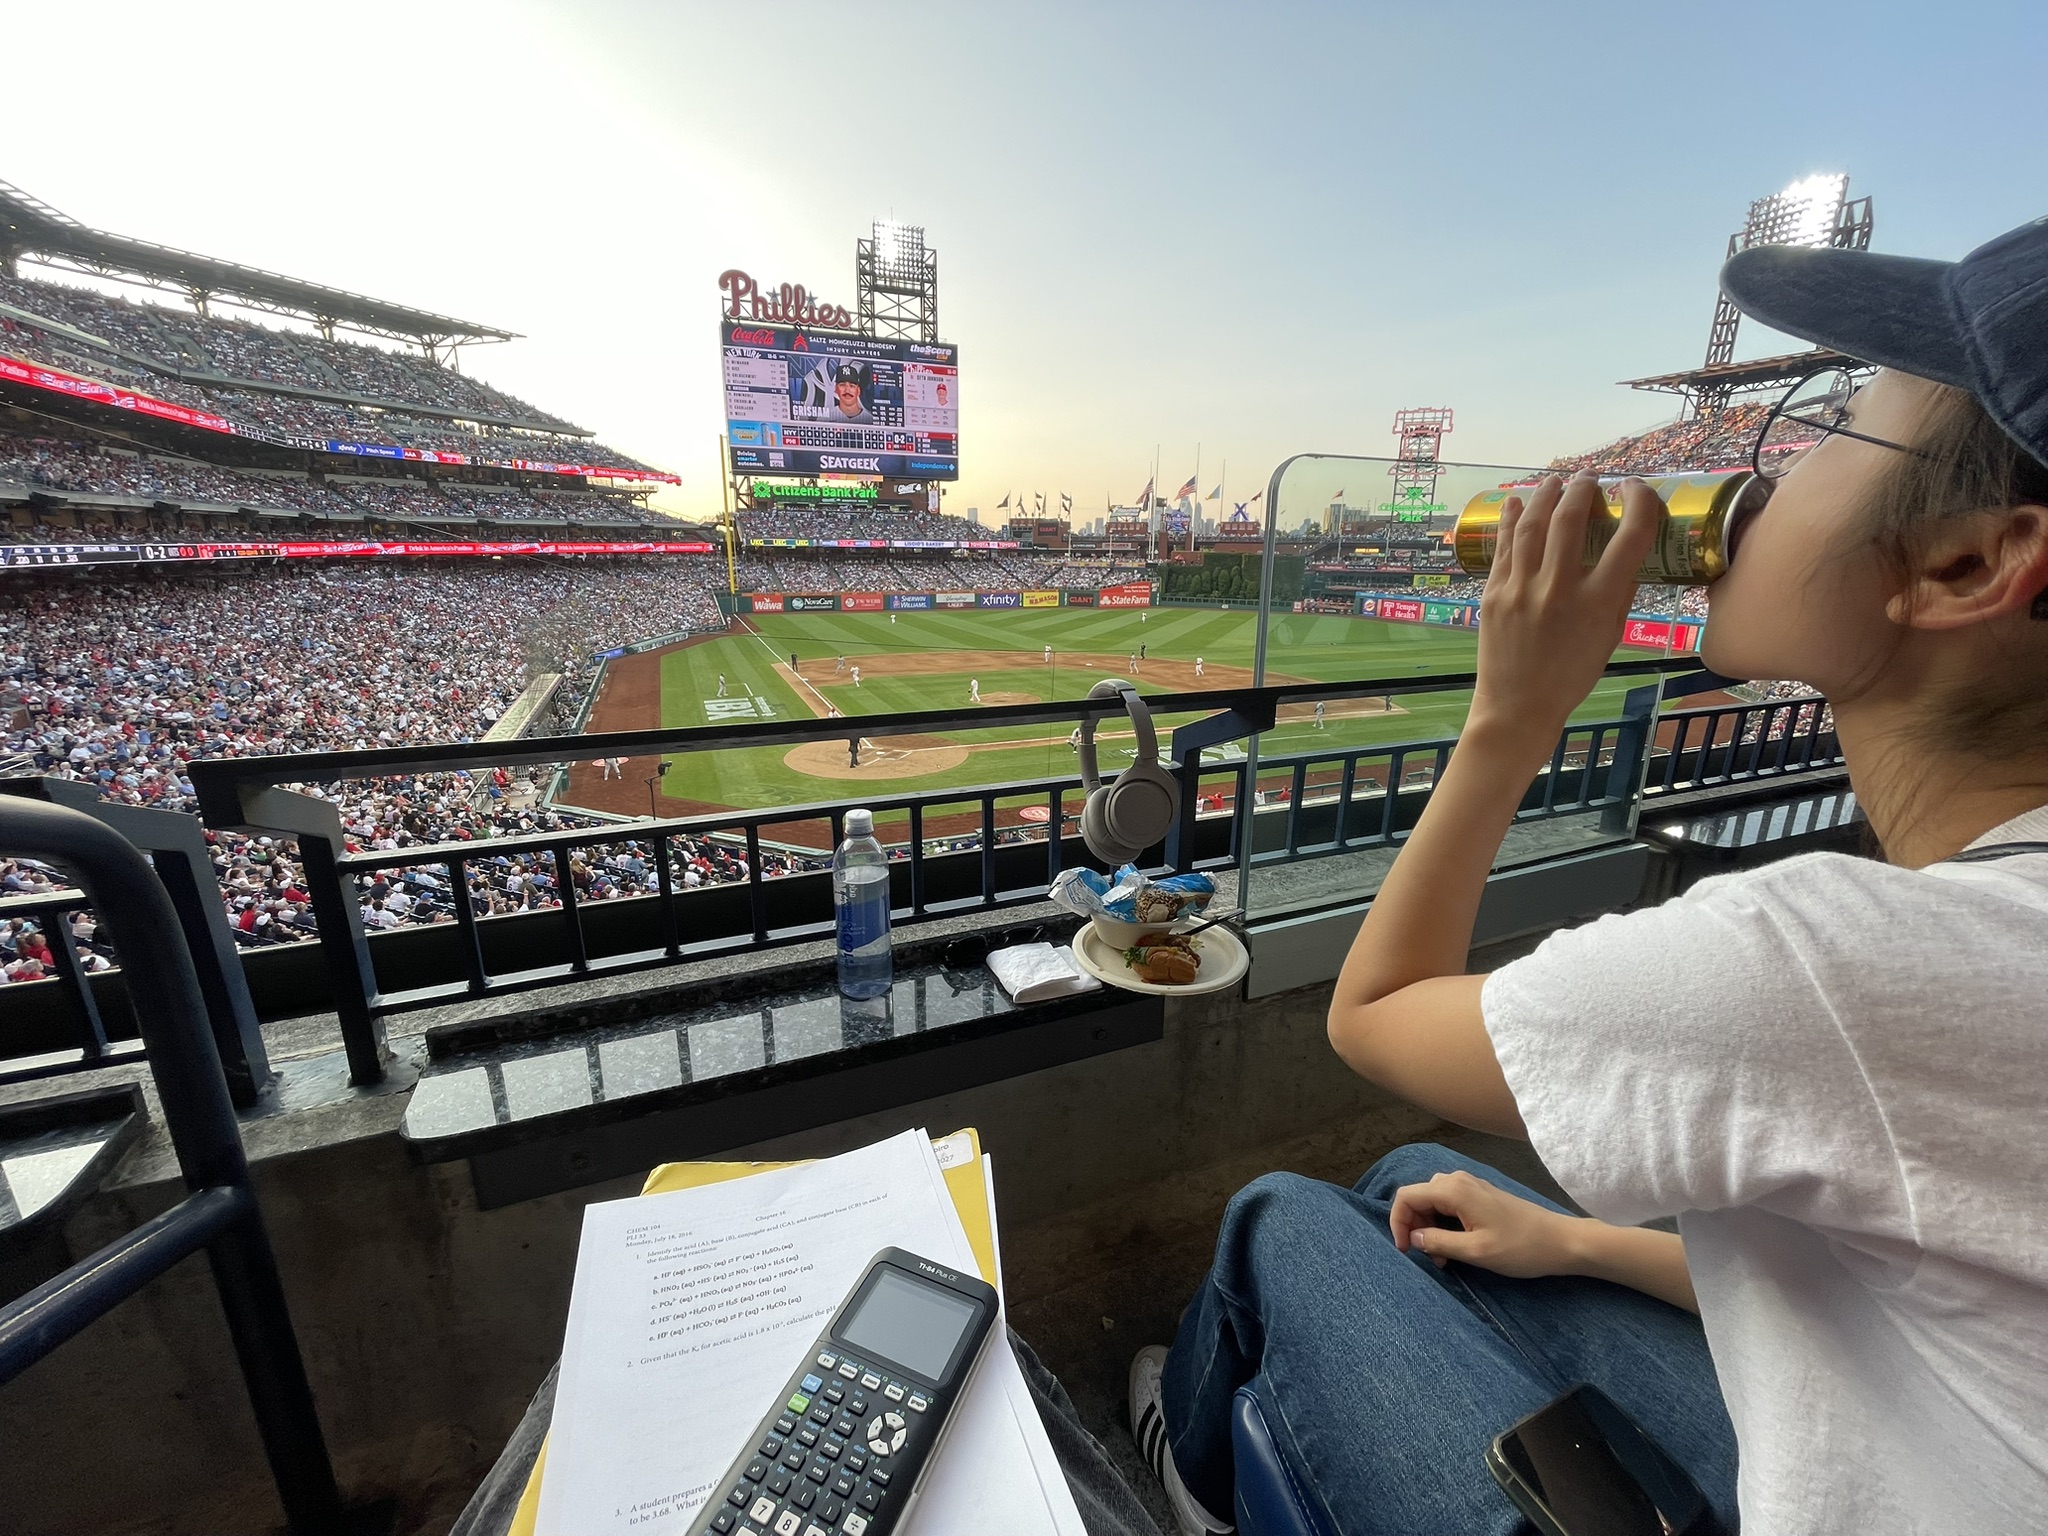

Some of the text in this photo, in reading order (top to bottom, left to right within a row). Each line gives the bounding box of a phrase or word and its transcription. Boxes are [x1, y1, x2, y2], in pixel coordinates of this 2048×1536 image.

[718, 269, 852, 329] Phillies
[809, 336, 827, 344] SALTZ
[867, 341, 897, 351] BENDESKY
[853, 349, 881, 357] LAWYERS
[909, 344, 952, 356] theScore
[792, 405, 830, 418] GRISHAM
[894, 434, 905, 444] 0-2
[820, 454, 880, 471] SEATGEEK
[911, 462, 948, 470] Independence
[772, 484, 878, 499] Citizens Bank Park
[1400, 512, 1422, 522] Park
[145, 546, 167, 559] 0-2
[754, 601, 782, 610] Wawa
[804, 597, 834, 606] NovaCare
[982, 594, 1016, 606] xfinity
[1112, 595, 1149, 605] State Farm
[1395, 601, 1418, 611] Temple
[1395, 609, 1416, 619] Health
[755, 1212, 778, 1222] Chapter
[626, 1226, 648, 1234] CHEM
[647, 1247, 671, 1258] Identify
[697, 1240, 710, 1248] (A),
[711, 1237, 724, 1245] base
[737, 1228, 765, 1239] conjugate
[766, 1224, 779, 1232] acid
[780, 1219, 796, 1230] (CA),
[808, 1210, 834, 1221] conjugate
[835, 1206, 847, 1214] base
[868, 1196, 881, 1204] each
[625, 1238, 653, 1248] Monday,
[654, 1235, 667, 1244] July
[678, 1231, 692, 1239] 2016
[658, 1251, 687, 1262] following
[672, 1268, 686, 1277] (aq)
[714, 1259, 727, 1268] (aq)
[742, 1252, 755, 1261] (aq)
[781, 1242, 794, 1251] (aq)
[680, 1280, 696, 1289] (aq)
[713, 1272, 727, 1282] (aq)
[753, 1262, 767, 1272] (aq)
[785, 1254, 799, 1263] (aq)
[919, 1262, 959, 1282] TI-84 Plus CE
[640, 1354, 662, 1365] Given
[663, 1351, 677, 1360] that
[678, 1348, 690, 1357] the
[700, 1342, 711, 1351] for
[712, 1338, 731, 1348] acetic
[733, 1333, 747, 1343] acid
[755, 1326, 765, 1336] 1.8
[786, 1314, 814, 1327] calculate
[815, 1310, 825, 1320] the
[826, 1388, 841, 1399] mode
[888, 1387, 901, 1397] trace
[852, 1400, 863, 1409] del
[910, 1399, 925, 1410] graph
[778, 1419, 792, 1430] math
[839, 1421, 852, 1431] stat
[801, 1430, 815, 1441] apps
[823, 1442, 839, 1454] prgm
[789, 1454, 799, 1463] sin
[850, 1455, 863, 1466] vars
[812, 1467, 824, 1476] cos
[873, 1467, 890, 1480] clear
[837, 1479, 848, 1490] tan
[733, 1488, 744, 1500] log
[614, 1509, 623, 1517] 3.
[630, 1504, 638, 1513] A
[640, 1495, 670, 1510] student
[672, 1485, 706, 1503] prepares
[629, 1498, 698, 1525] to be 3.68. What
[757, 1504, 768, 1516] 7
[718, 1516, 726, 1524] ln
[782, 1518, 793, 1531] 8
